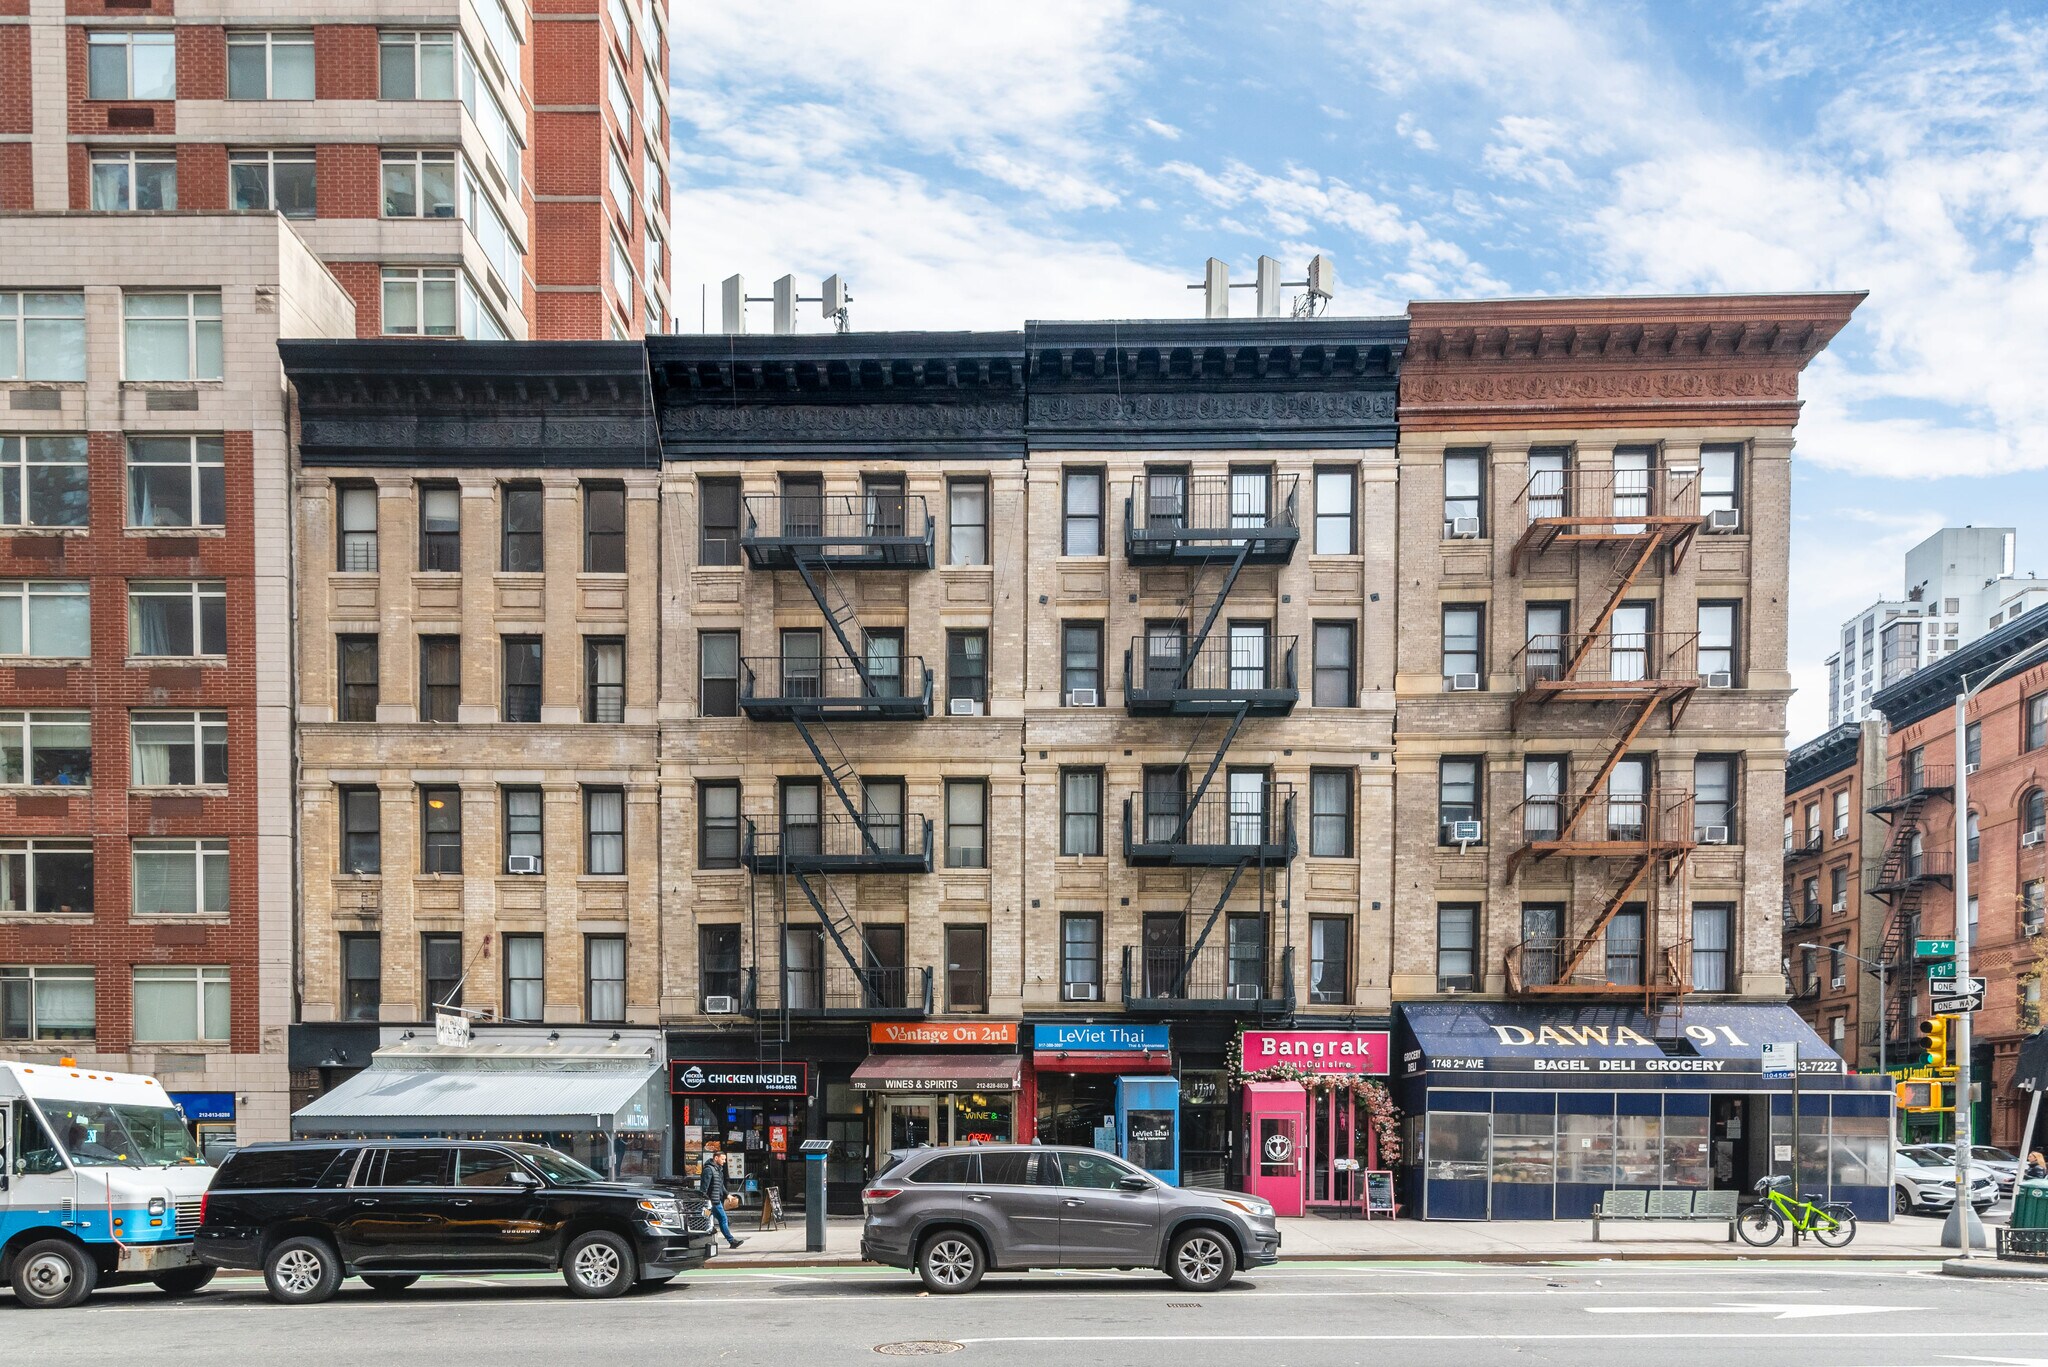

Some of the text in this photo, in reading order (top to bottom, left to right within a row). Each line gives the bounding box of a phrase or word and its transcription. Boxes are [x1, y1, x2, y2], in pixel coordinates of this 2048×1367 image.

[1931, 942, 1938, 953] 2
[1930, 967, 1935, 977] E
[1937, 965, 1946, 976] 91
[1937, 983, 1954, 991] ONE
[1937, 999, 1975, 1010] ONE WAY
[439, 1025, 468, 1037] MILTON
[953, 1026, 977, 1041] On
[1059, 1029, 1144, 1043] LeViet Thai
[1488, 1025, 1750, 1047] DAWA 91
[1261, 1037, 1370, 1057] Bangrak
[1764, 1044, 1771, 1052] 2
[1403, 1049, 1422, 1062] GROCERY
[1407, 1061, 1417, 1073] DELI
[1431, 1059, 1484, 1069] 1748 2nd AVE
[1534, 1060, 1725, 1071] BAGEL DELI GROCERY
[708, 1074, 797, 1084] CHICKEN INSIDER
[885, 1080, 958, 1089] WINES & SPIRITS
[626, 1114, 649, 1127] MILTON
[965, 1112, 998, 1120] WINE &
[1105, 1116, 1113, 1125] A
[967, 1132, 992, 1142] OPEN
[1154, 1129, 1170, 1137] Thai
